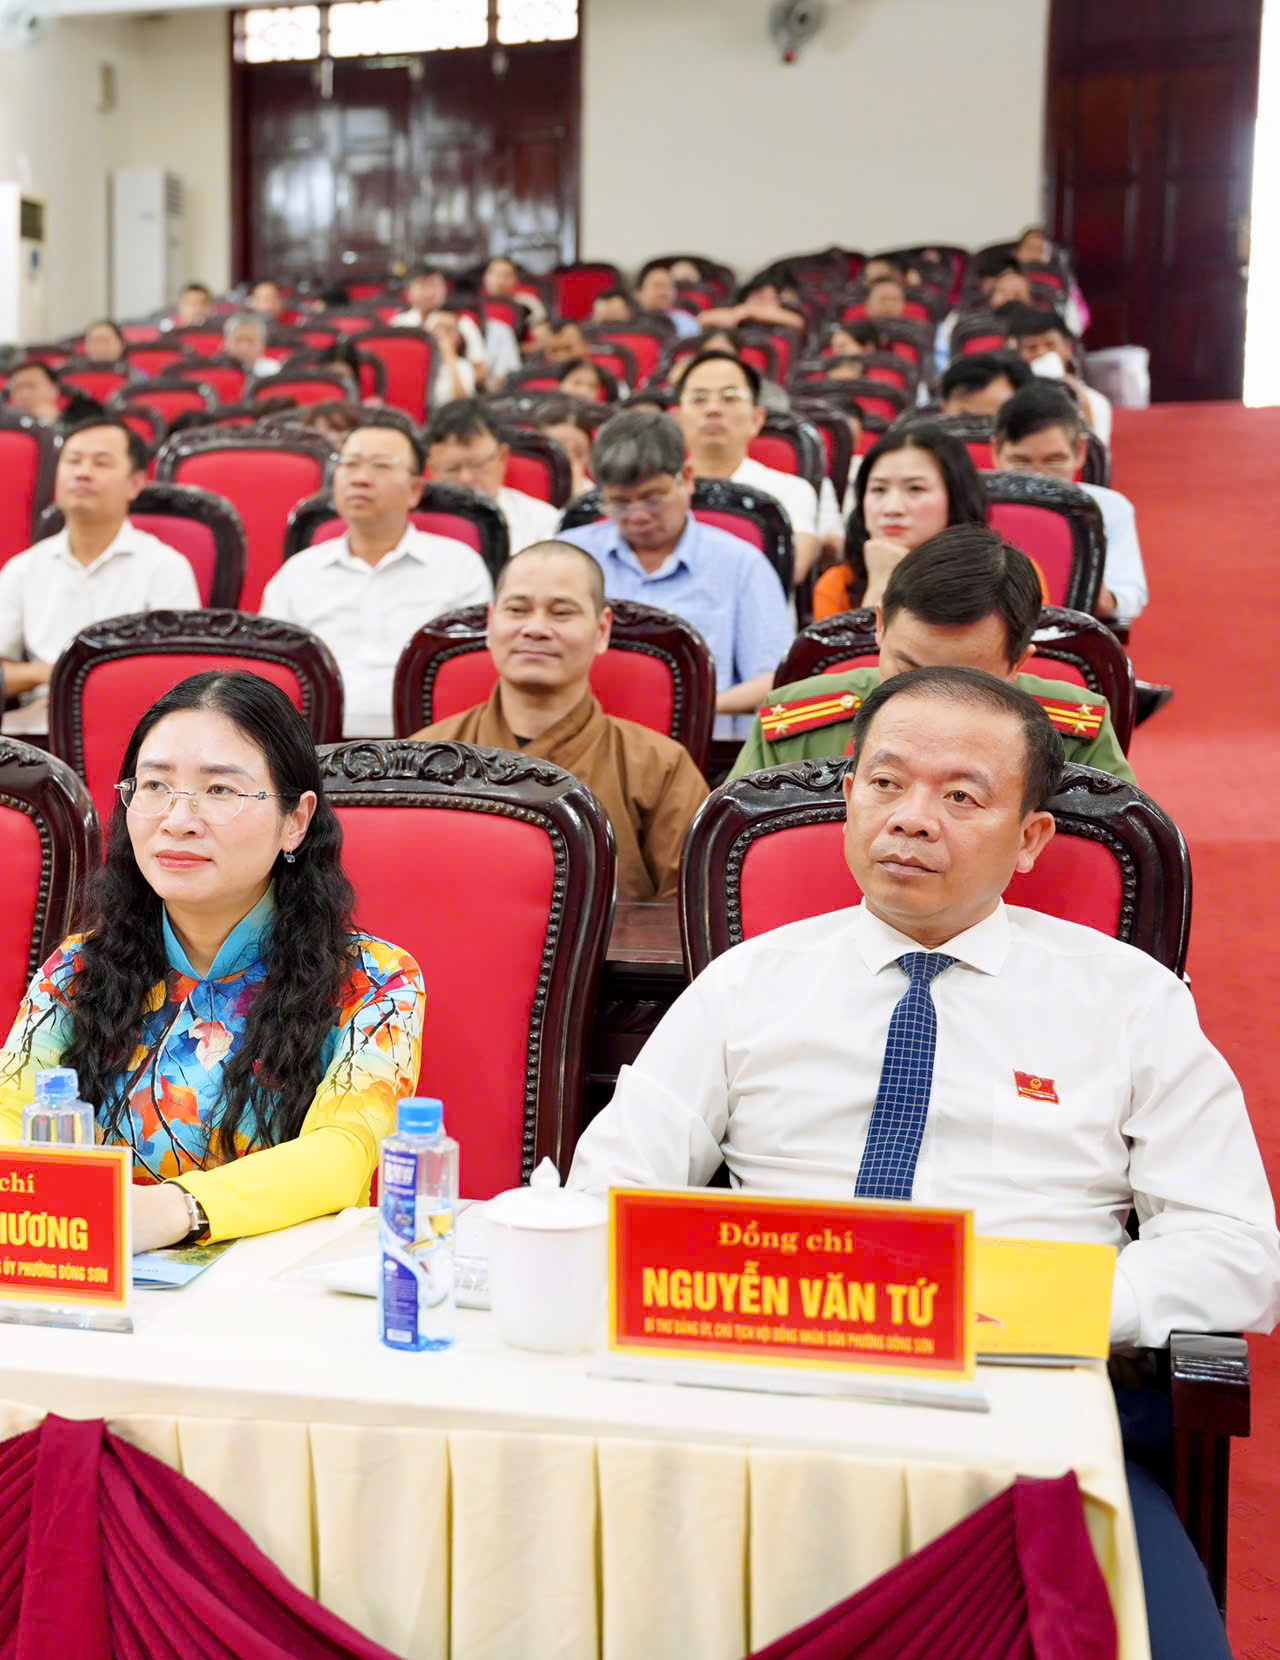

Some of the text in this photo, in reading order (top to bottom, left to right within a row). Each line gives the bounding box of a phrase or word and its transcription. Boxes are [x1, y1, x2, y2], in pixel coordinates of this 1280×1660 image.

[719, 1220, 854, 1252] Đồng chí
[642, 1261, 938, 1326] NGUYỄN VĂN TỨ
